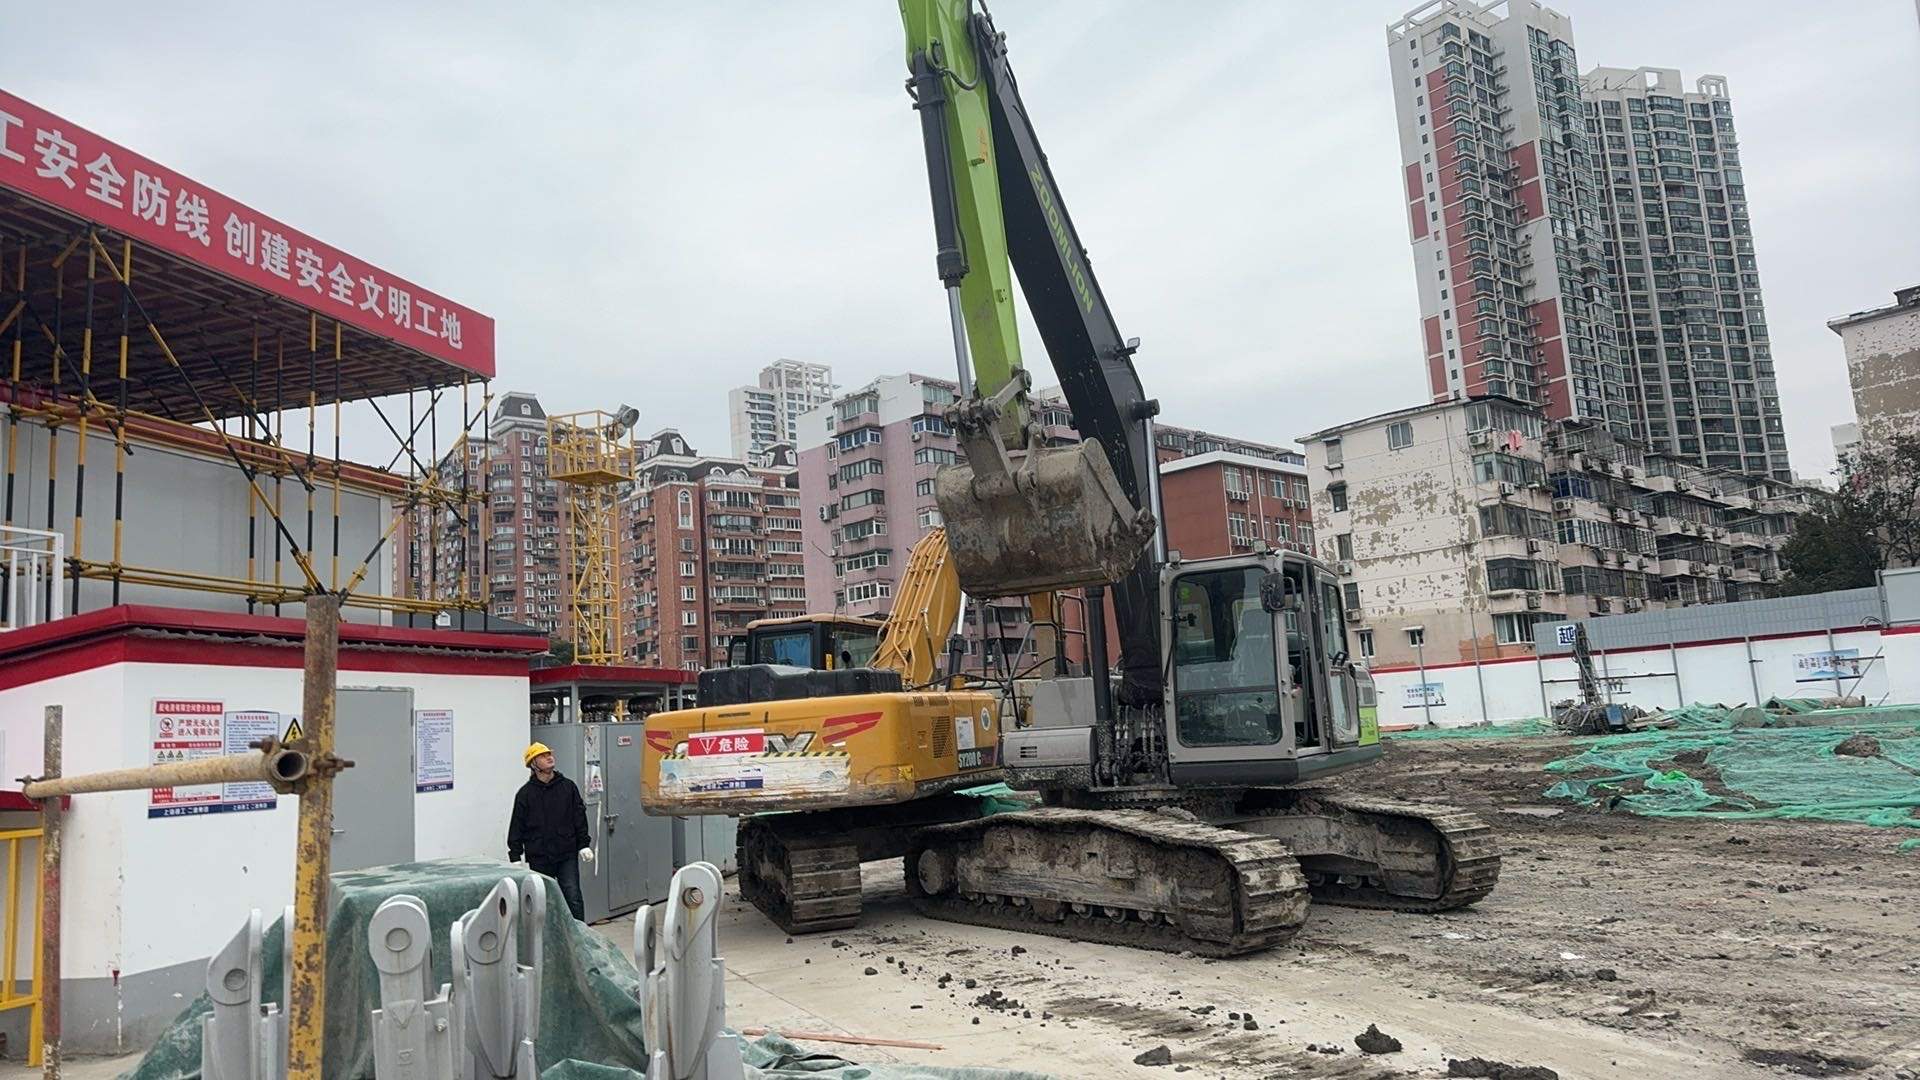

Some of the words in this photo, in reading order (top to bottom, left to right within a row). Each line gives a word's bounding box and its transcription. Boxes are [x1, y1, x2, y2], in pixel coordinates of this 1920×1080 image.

[0, 110, 211, 247] 工安全防线
[224, 211, 464, 351] 创建安全文明工地
[1030, 163, 1094, 315] ZOOMLION
[718, 736, 750, 753] 危险
